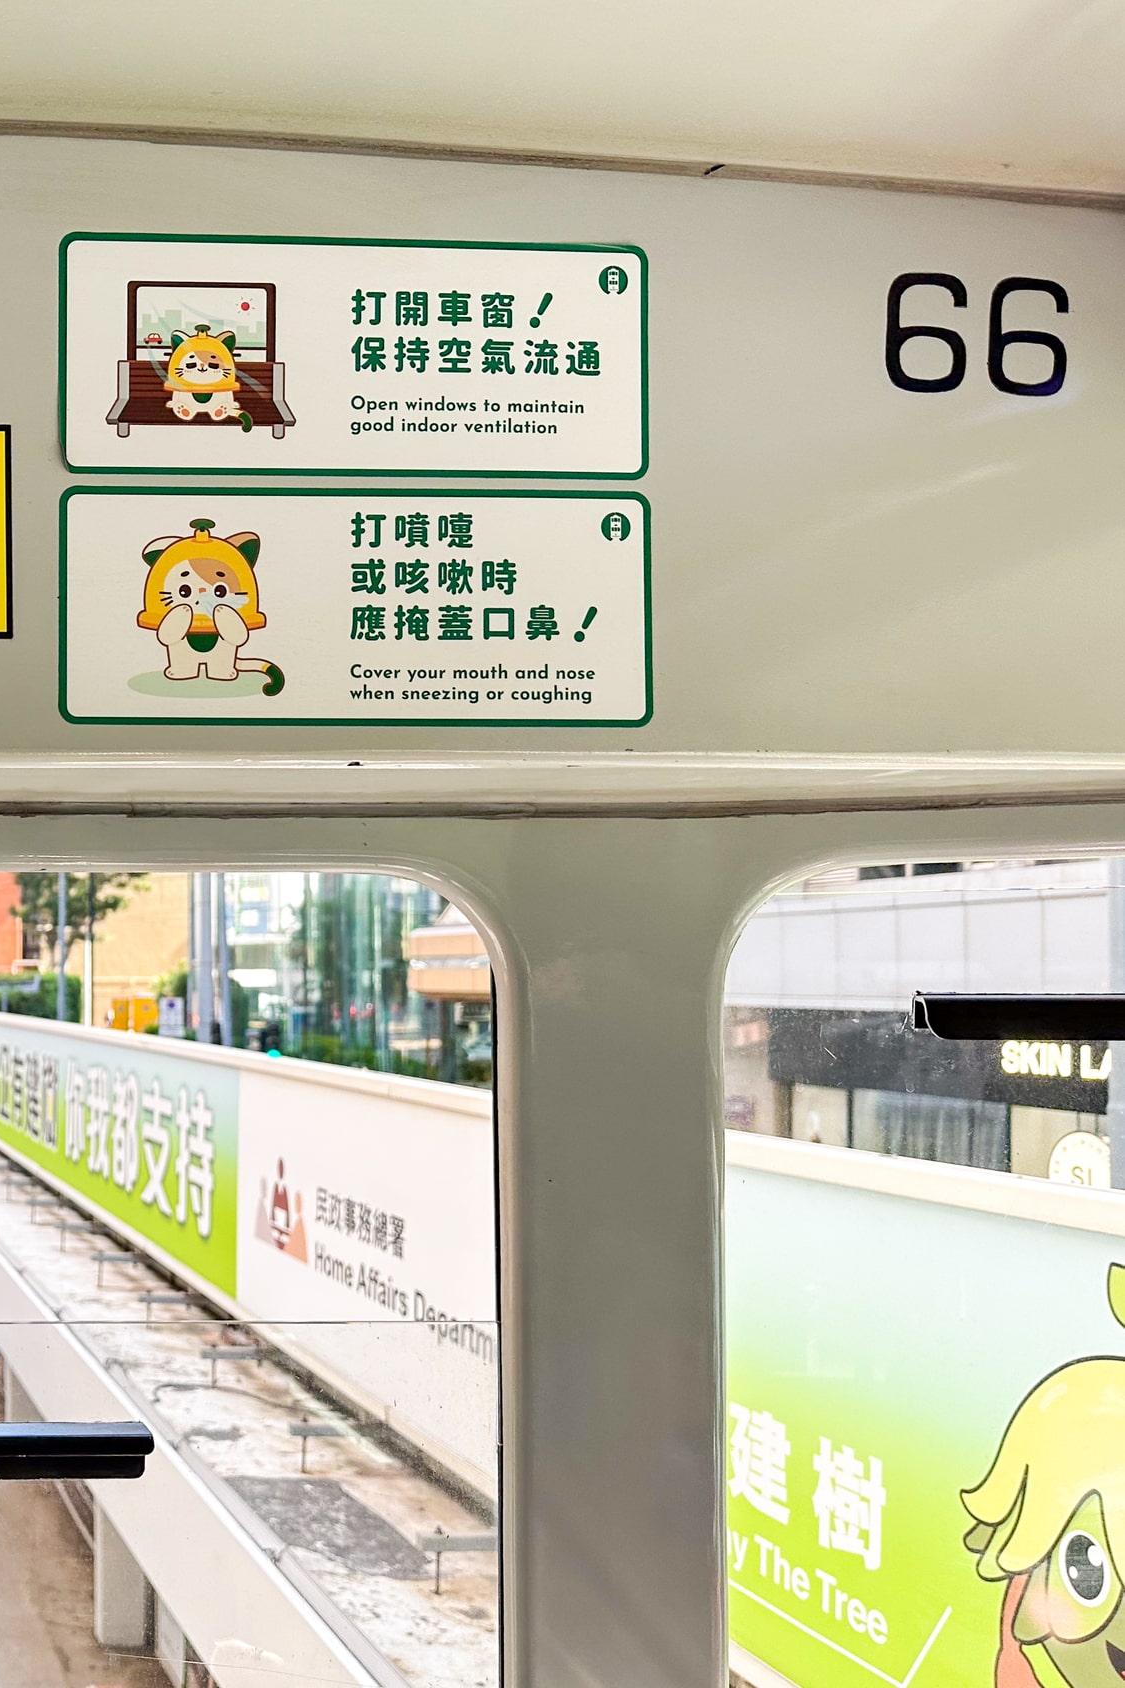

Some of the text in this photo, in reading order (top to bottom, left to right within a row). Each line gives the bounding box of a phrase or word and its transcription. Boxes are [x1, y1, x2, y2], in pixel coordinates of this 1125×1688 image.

[351, 289, 554, 328] 打開車窗！
[885, 272, 1069, 396] 66
[351, 336, 602, 376] 保持空氣流通
[350, 395, 585, 414] Open windows to maintain
[350, 416, 558, 434] good indoor ventilation
[350, 512, 473, 548] 打噴嚏
[350, 558, 517, 595] 或咳嗽時
[350, 604, 598, 642] 應掩蓋口鼻！
[350, 664, 596, 682] Cover your mouth and nose
[350, 685, 592, 704] when sneezing or coughing
[1001, 1041, 1072, 1077] SKIN
[64, 1054, 215, 1240] 你我都支持
[315, 1241, 354, 1288] Home
[356, 1262, 408, 1318] Affairs
[728, 1401, 886, 1571] 建樹
[753, 1533, 811, 1601] The
[814, 1567, 889, 1645] Tree
